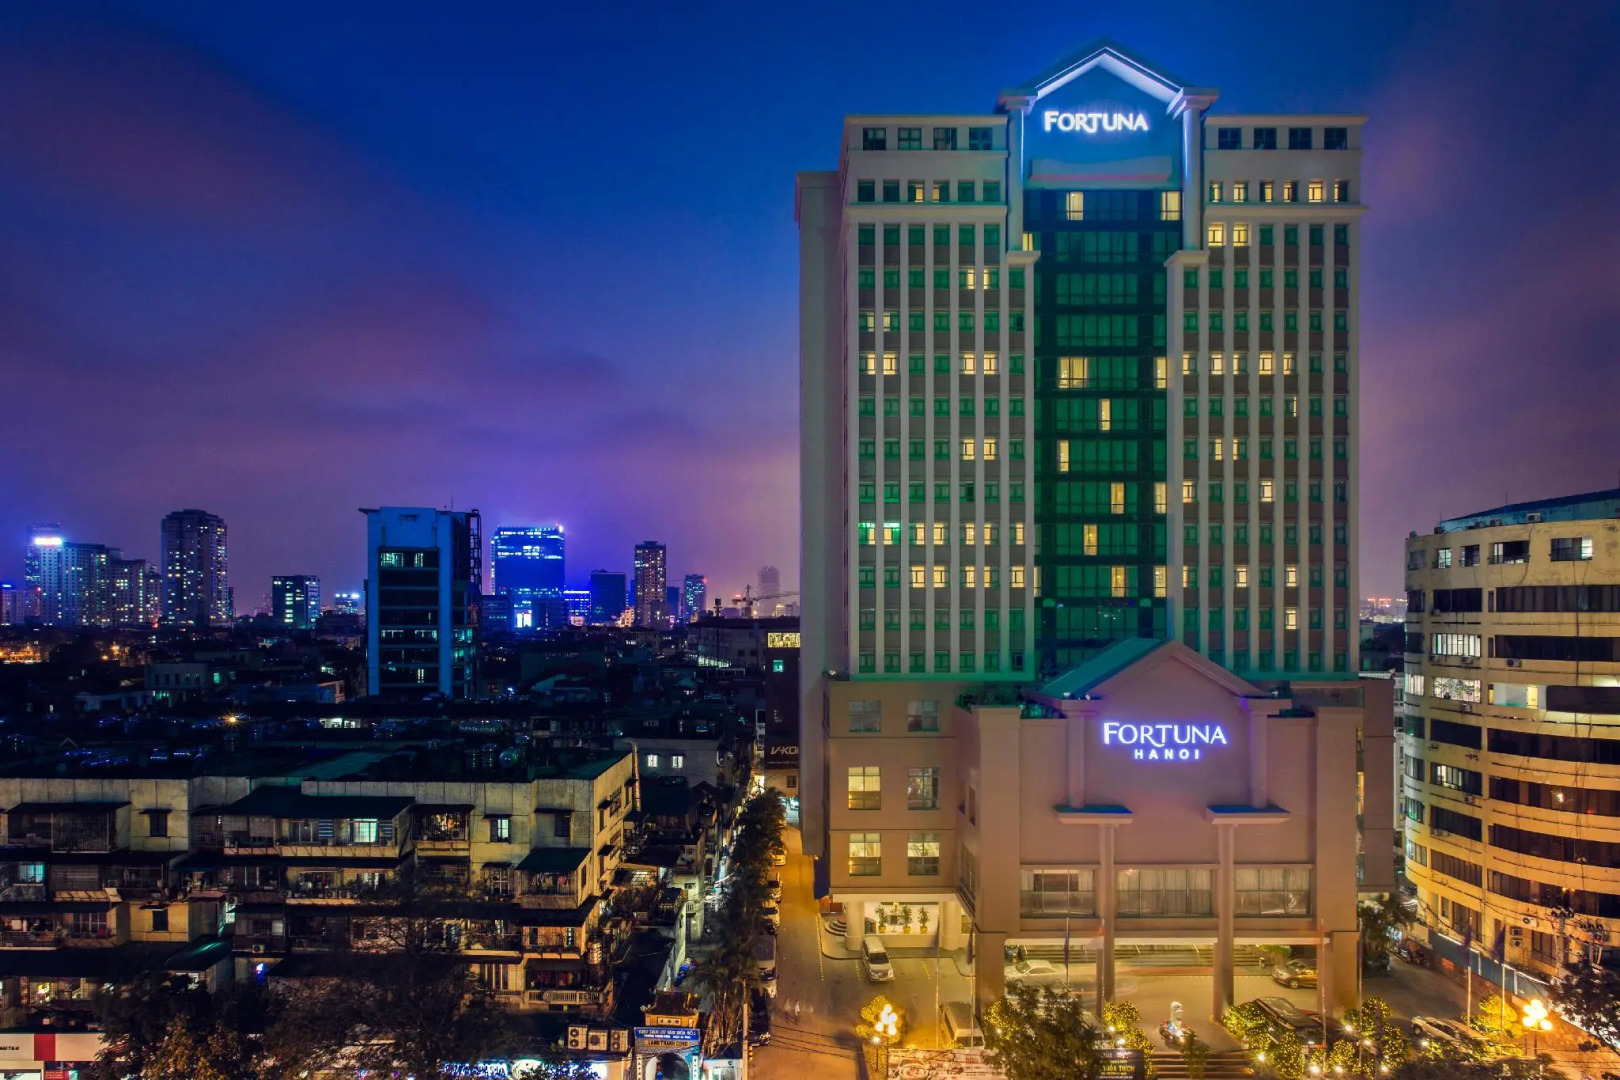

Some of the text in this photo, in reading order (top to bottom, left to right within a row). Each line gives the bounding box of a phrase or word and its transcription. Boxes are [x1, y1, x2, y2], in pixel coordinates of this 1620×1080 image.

[1044, 111, 1149, 133] FORTUNA
[1103, 722, 1228, 747] FORTUNA
[1134, 748, 1200, 759] HANOI
